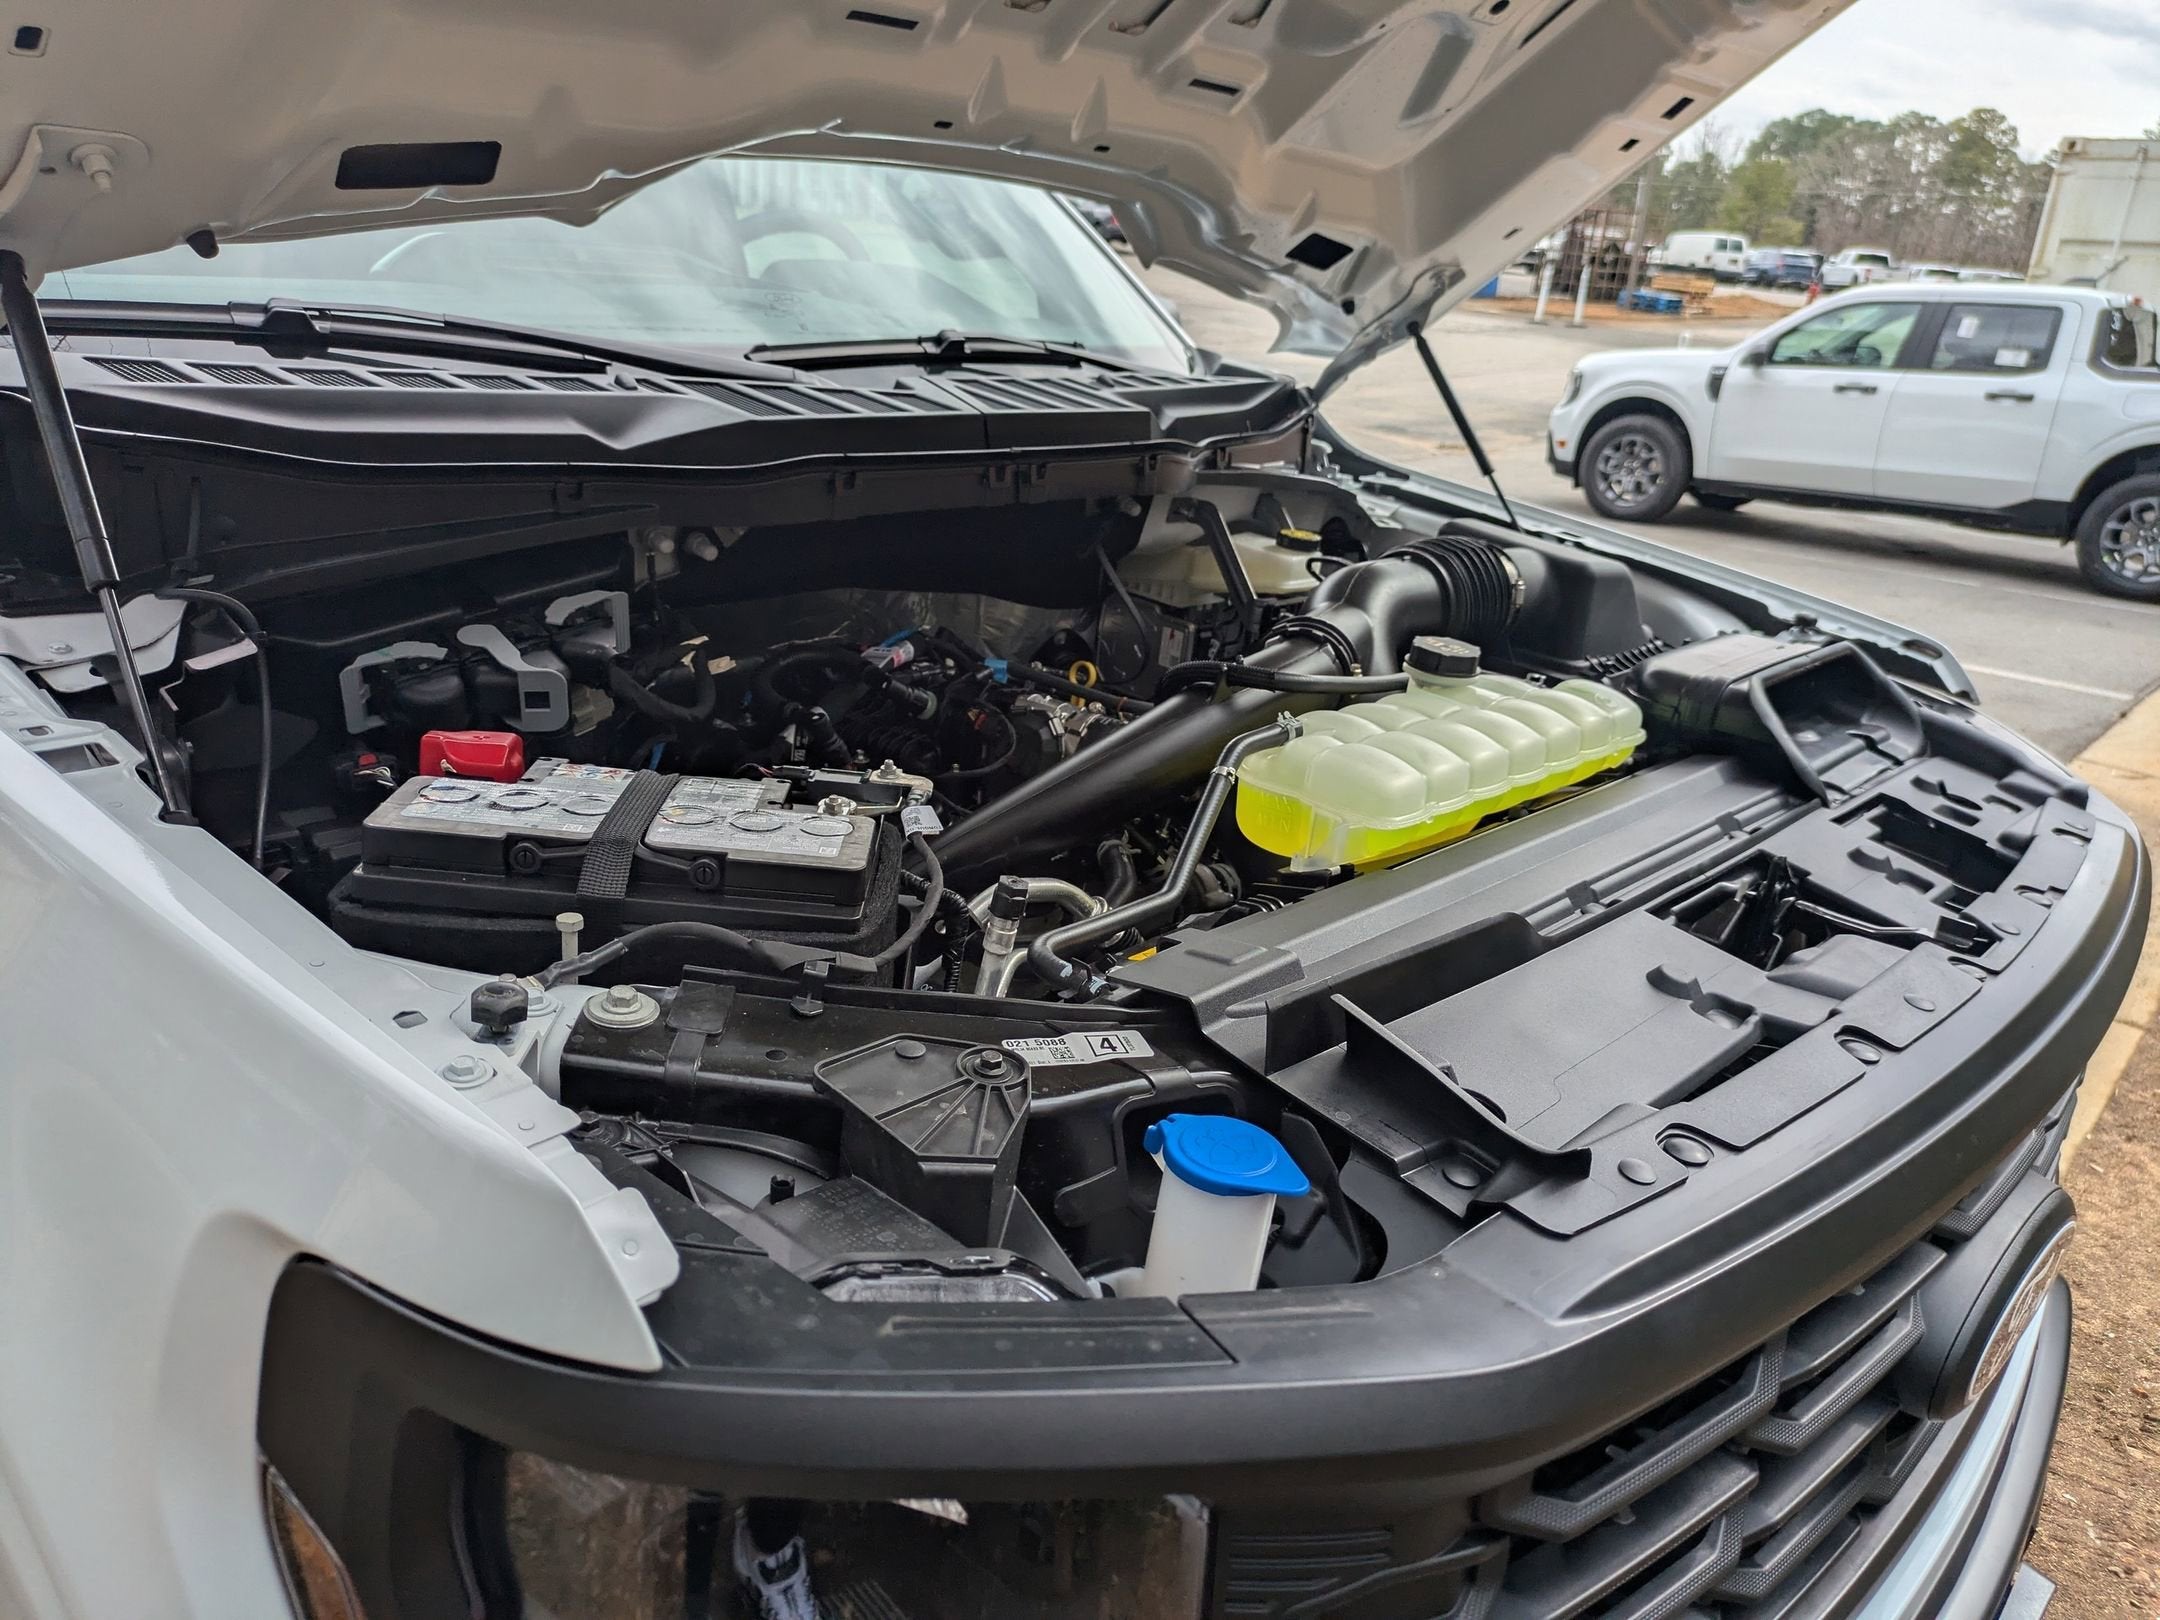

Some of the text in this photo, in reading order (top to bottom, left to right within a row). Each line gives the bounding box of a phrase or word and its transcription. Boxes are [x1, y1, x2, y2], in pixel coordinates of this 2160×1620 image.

[1005, 1038, 1067, 1048] 021 5088
[1099, 1037, 1118, 1053] 4
